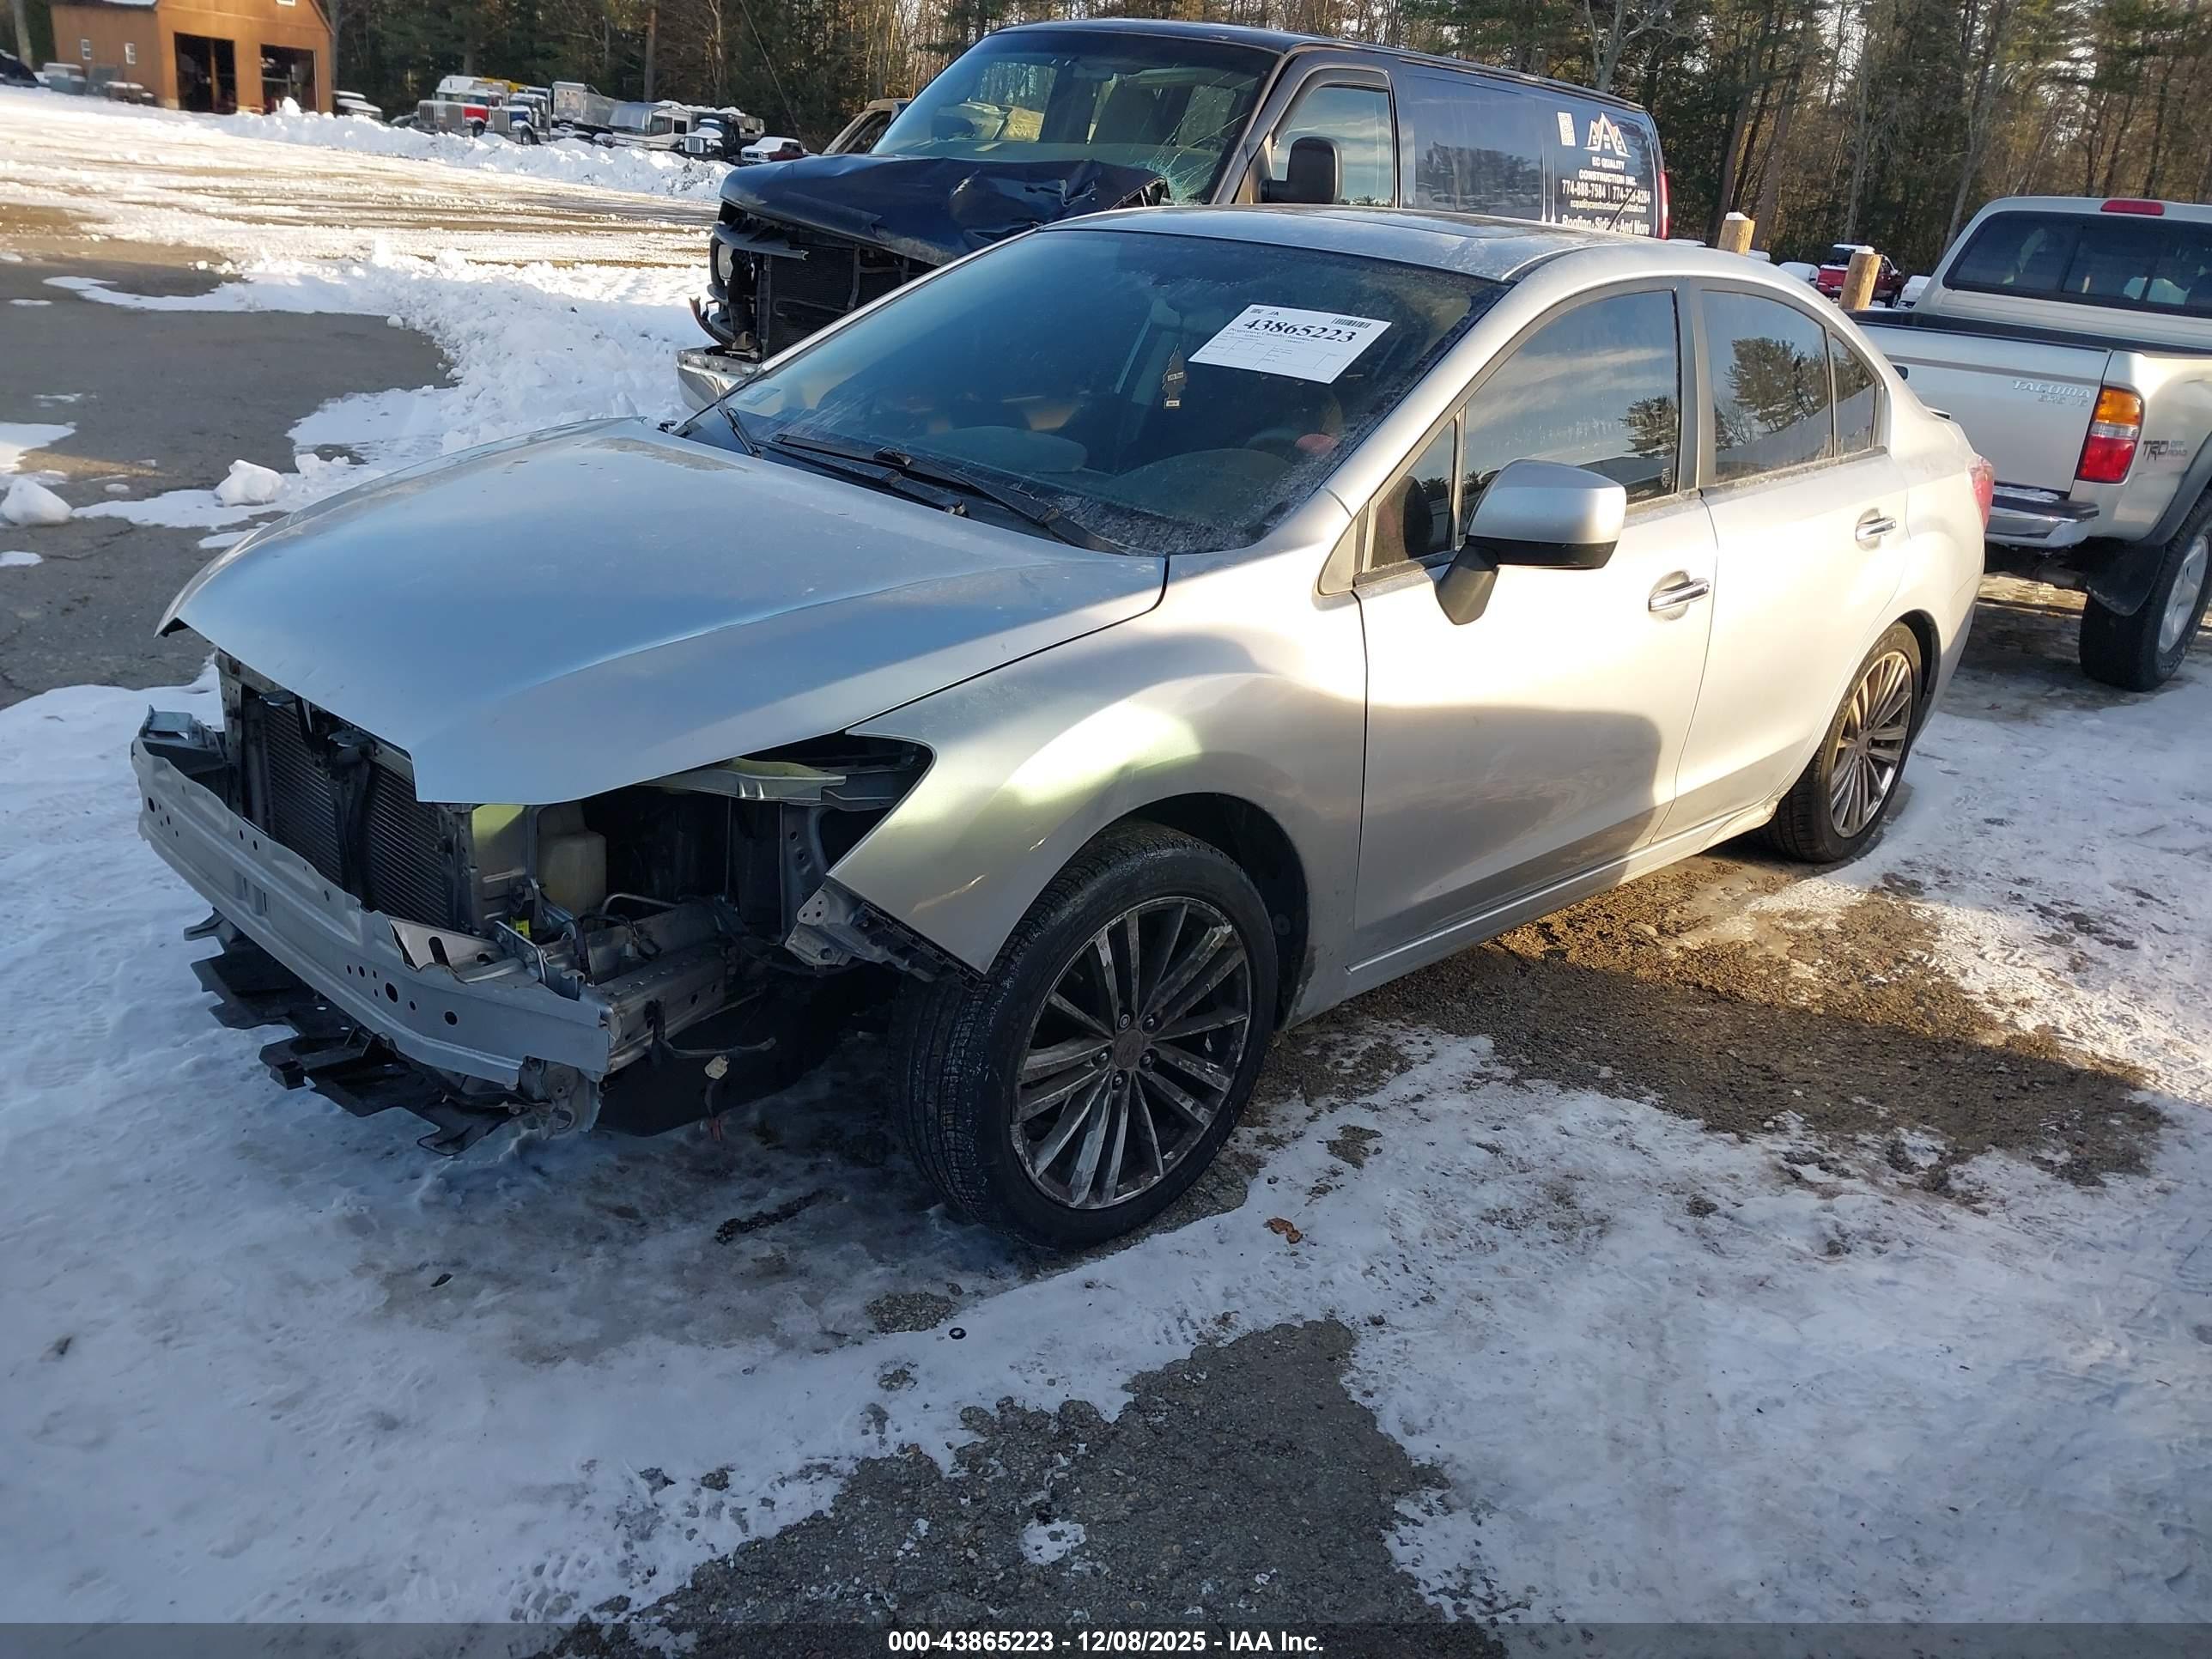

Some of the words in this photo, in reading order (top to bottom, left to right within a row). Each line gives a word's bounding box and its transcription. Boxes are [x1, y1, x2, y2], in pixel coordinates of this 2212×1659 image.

[1592, 156, 1601, 167] EC
[1601, 157, 1626, 170] QUALITY
[1578, 169, 1625, 185] CONSTRUCTION
[1626, 175, 1638, 186] INC.
[1562, 214, 1592, 230] Roofing
[1620, 218, 1633, 234] And
[1633, 220, 1650, 235] More
[1243, 319, 1357, 343] 43865223
[2012, 380, 2091, 398] TACOMA
[2143, 440, 2169, 460] TRD
